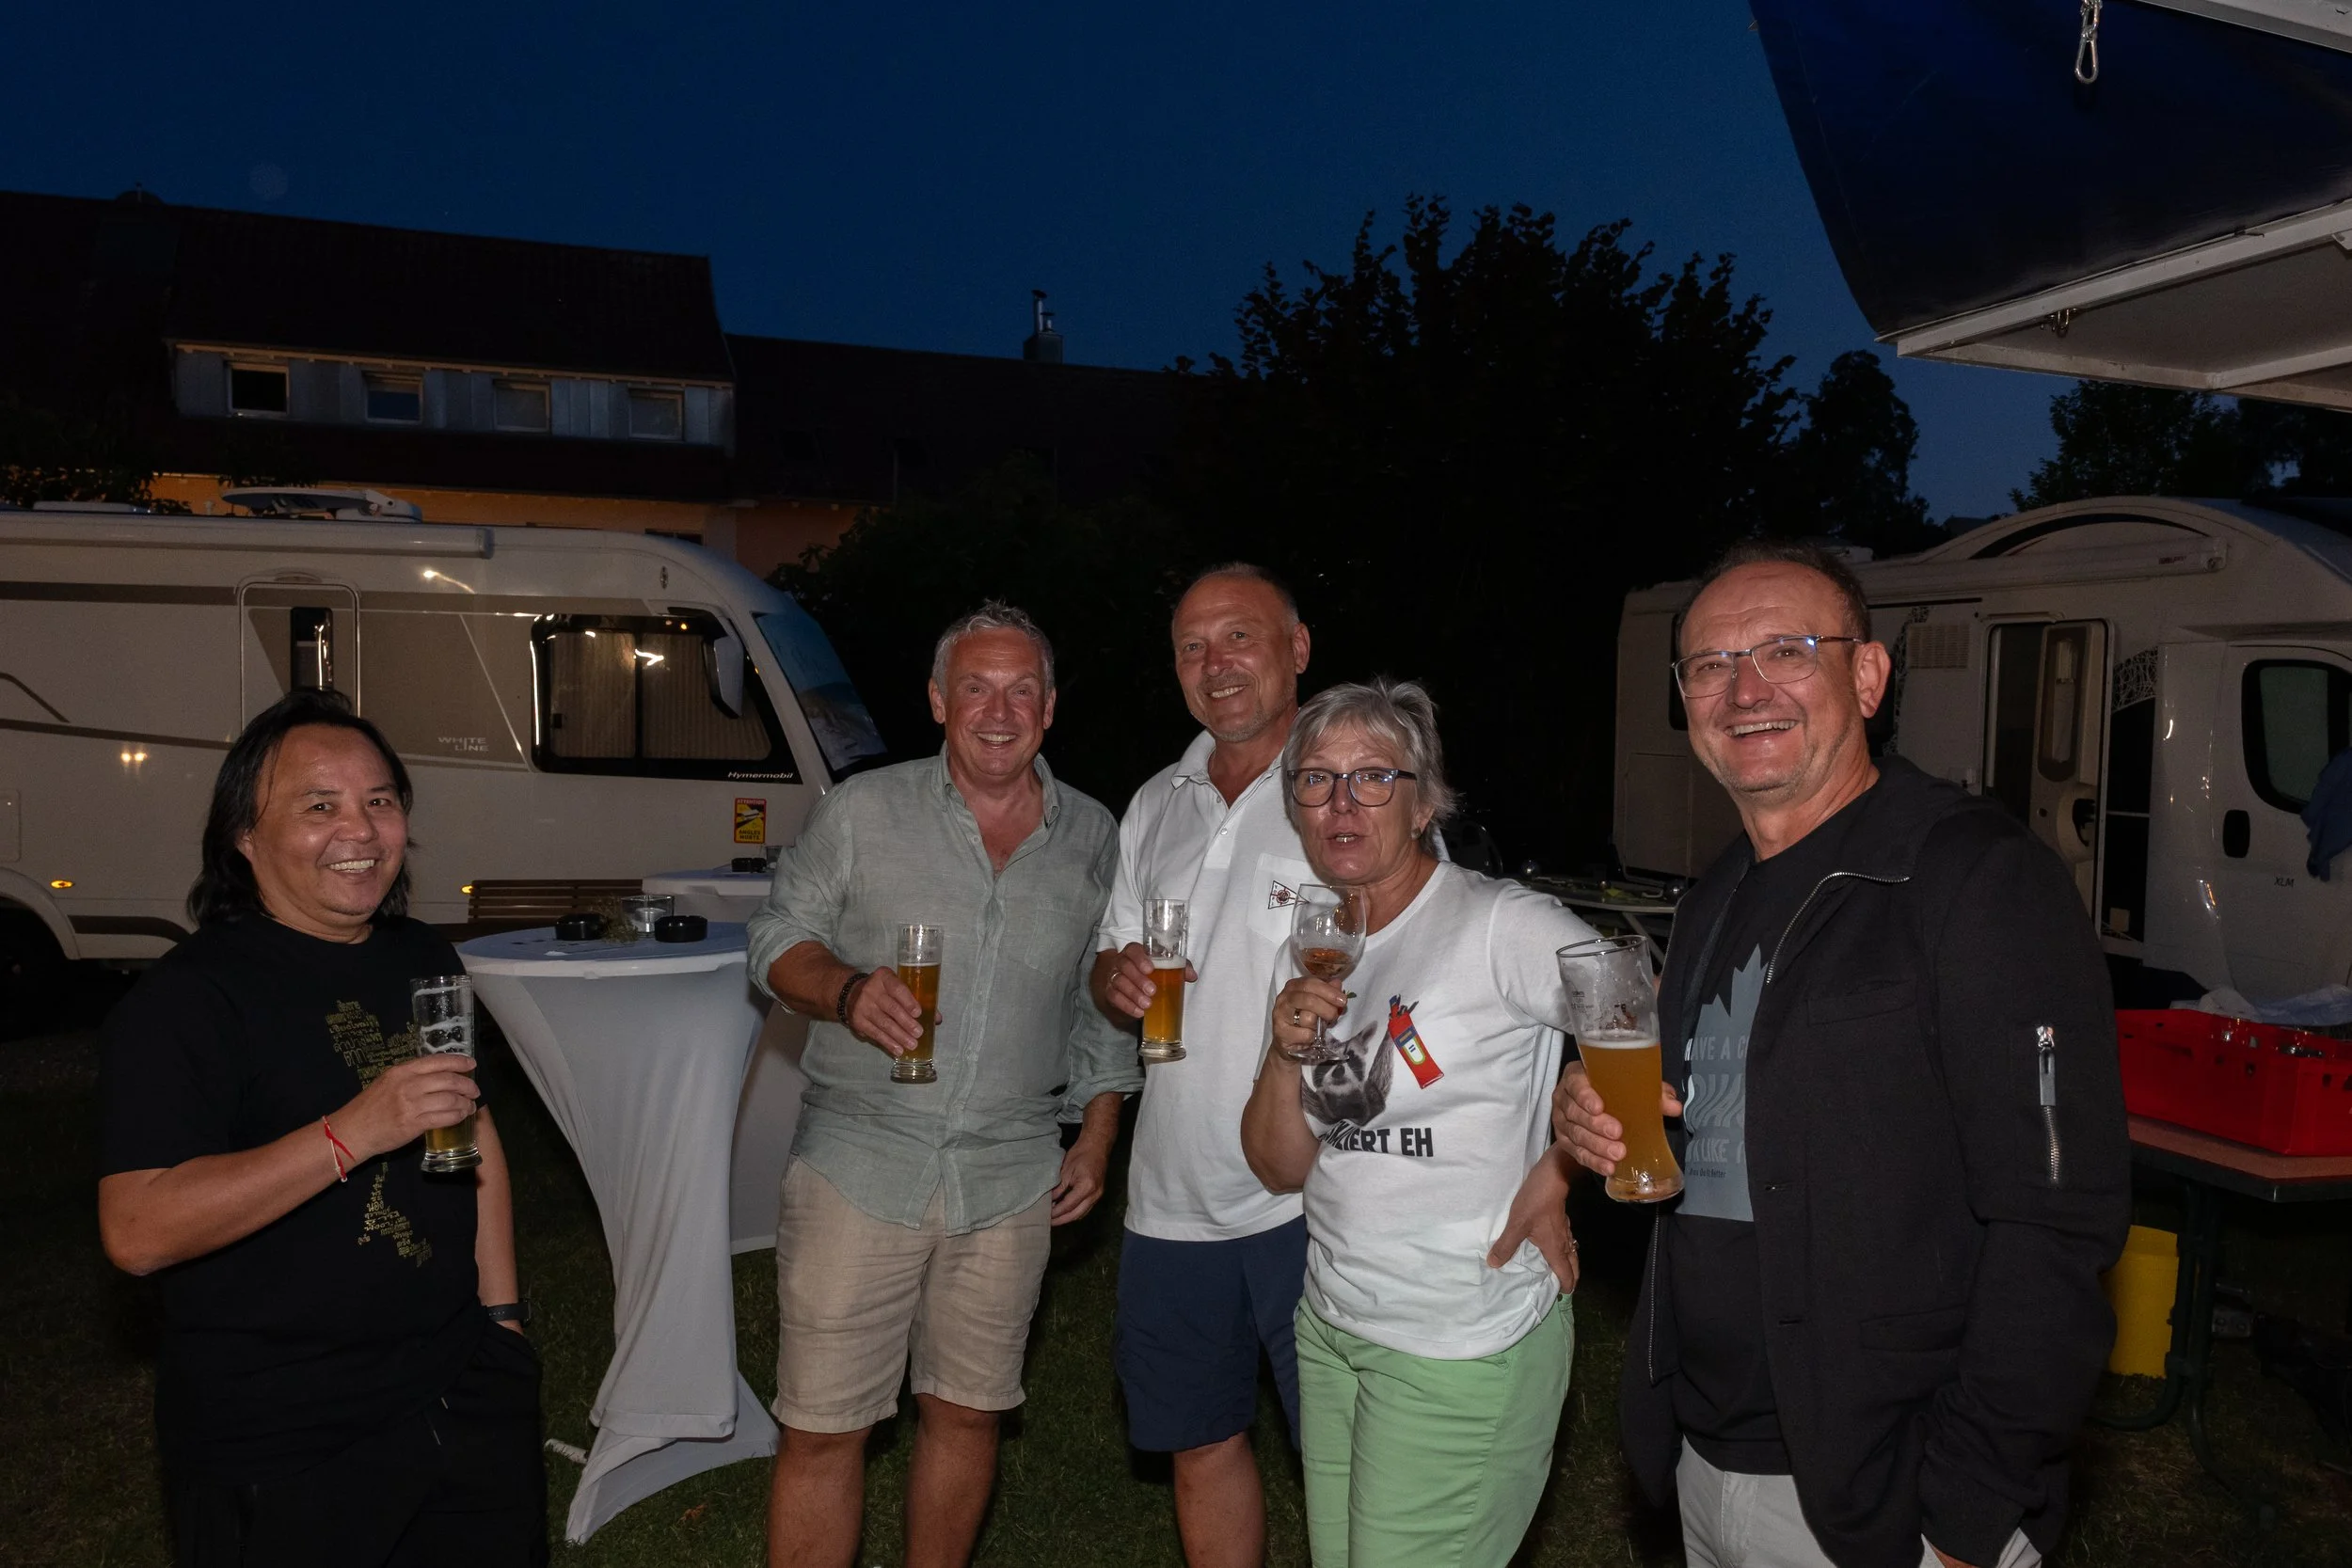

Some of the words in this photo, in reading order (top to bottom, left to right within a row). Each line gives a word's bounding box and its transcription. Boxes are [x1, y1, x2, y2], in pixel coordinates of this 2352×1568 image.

[437, 736, 486, 746] WHITE
[454, 742, 489, 752] LINE
[727, 771, 794, 780] Hymermobil
[1684, 1036, 1716, 1062] HAVE
[1720, 1036, 1731, 1061] A
[1400, 1127, 1434, 1158] EH
